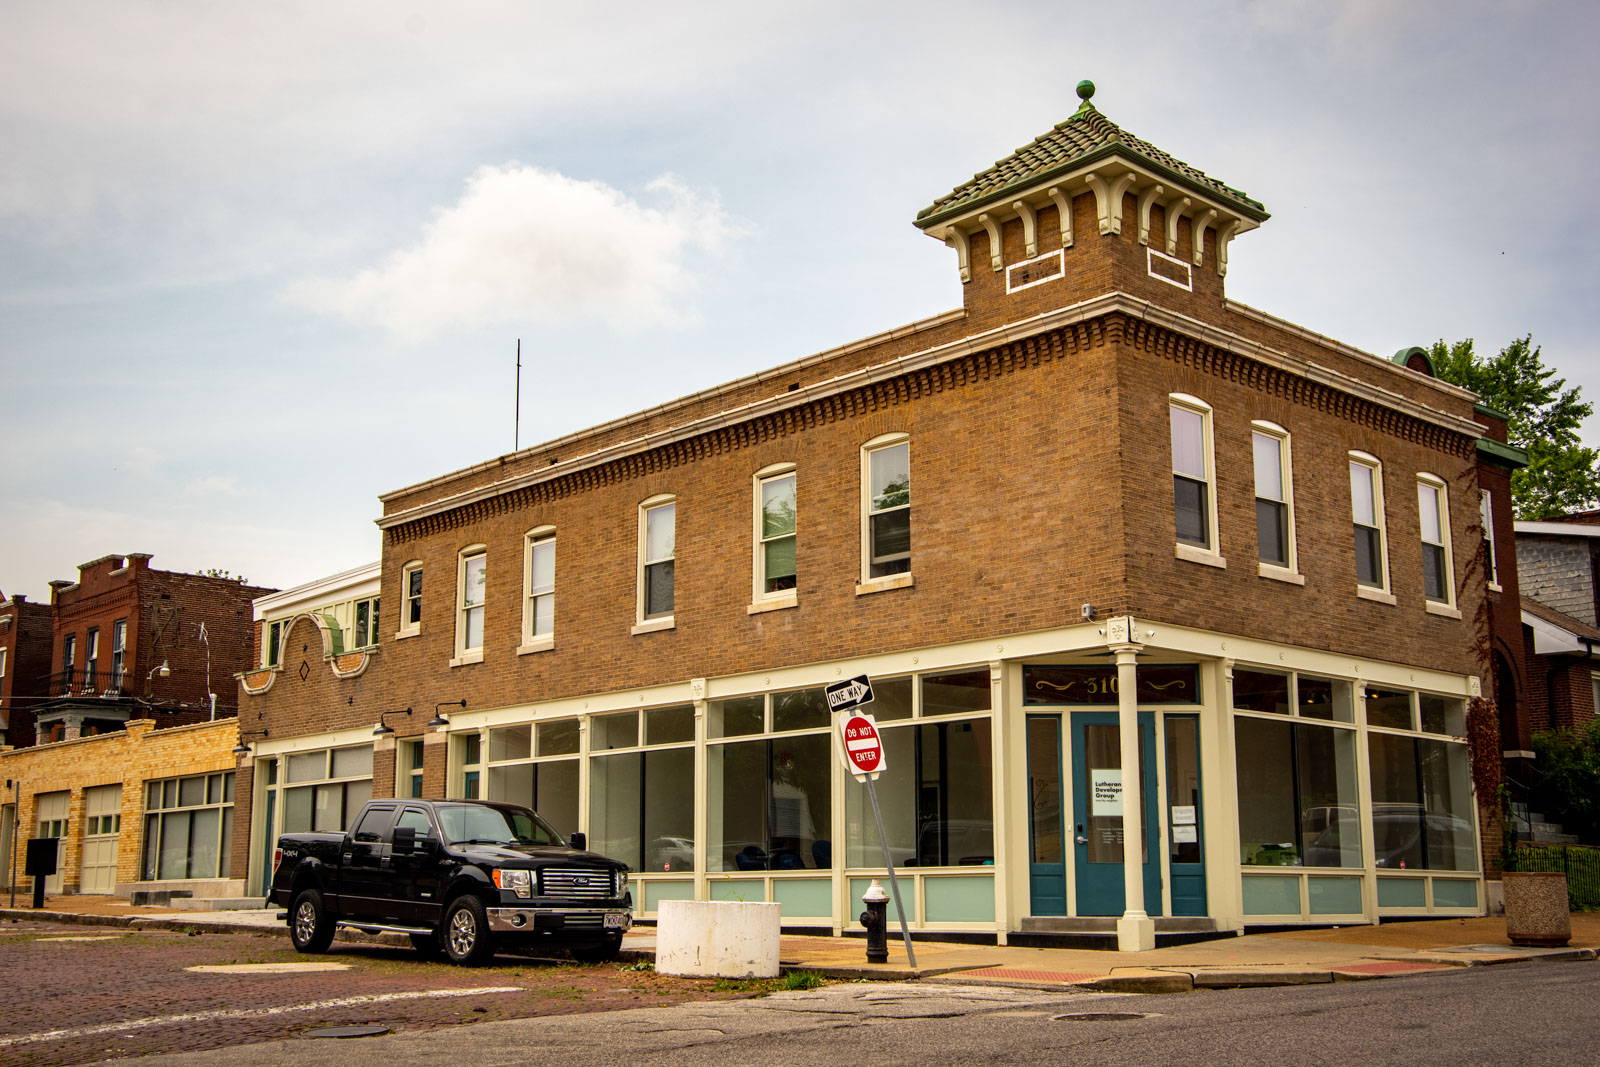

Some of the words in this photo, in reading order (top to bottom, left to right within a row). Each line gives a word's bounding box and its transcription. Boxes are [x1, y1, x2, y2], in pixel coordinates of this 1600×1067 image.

[830, 690, 846, 704] ONE
[847, 684, 863, 699] WAY
[847, 728, 857, 738] DO
[859, 726, 872, 737] NOT
[855, 751, 877, 762] ENTER
